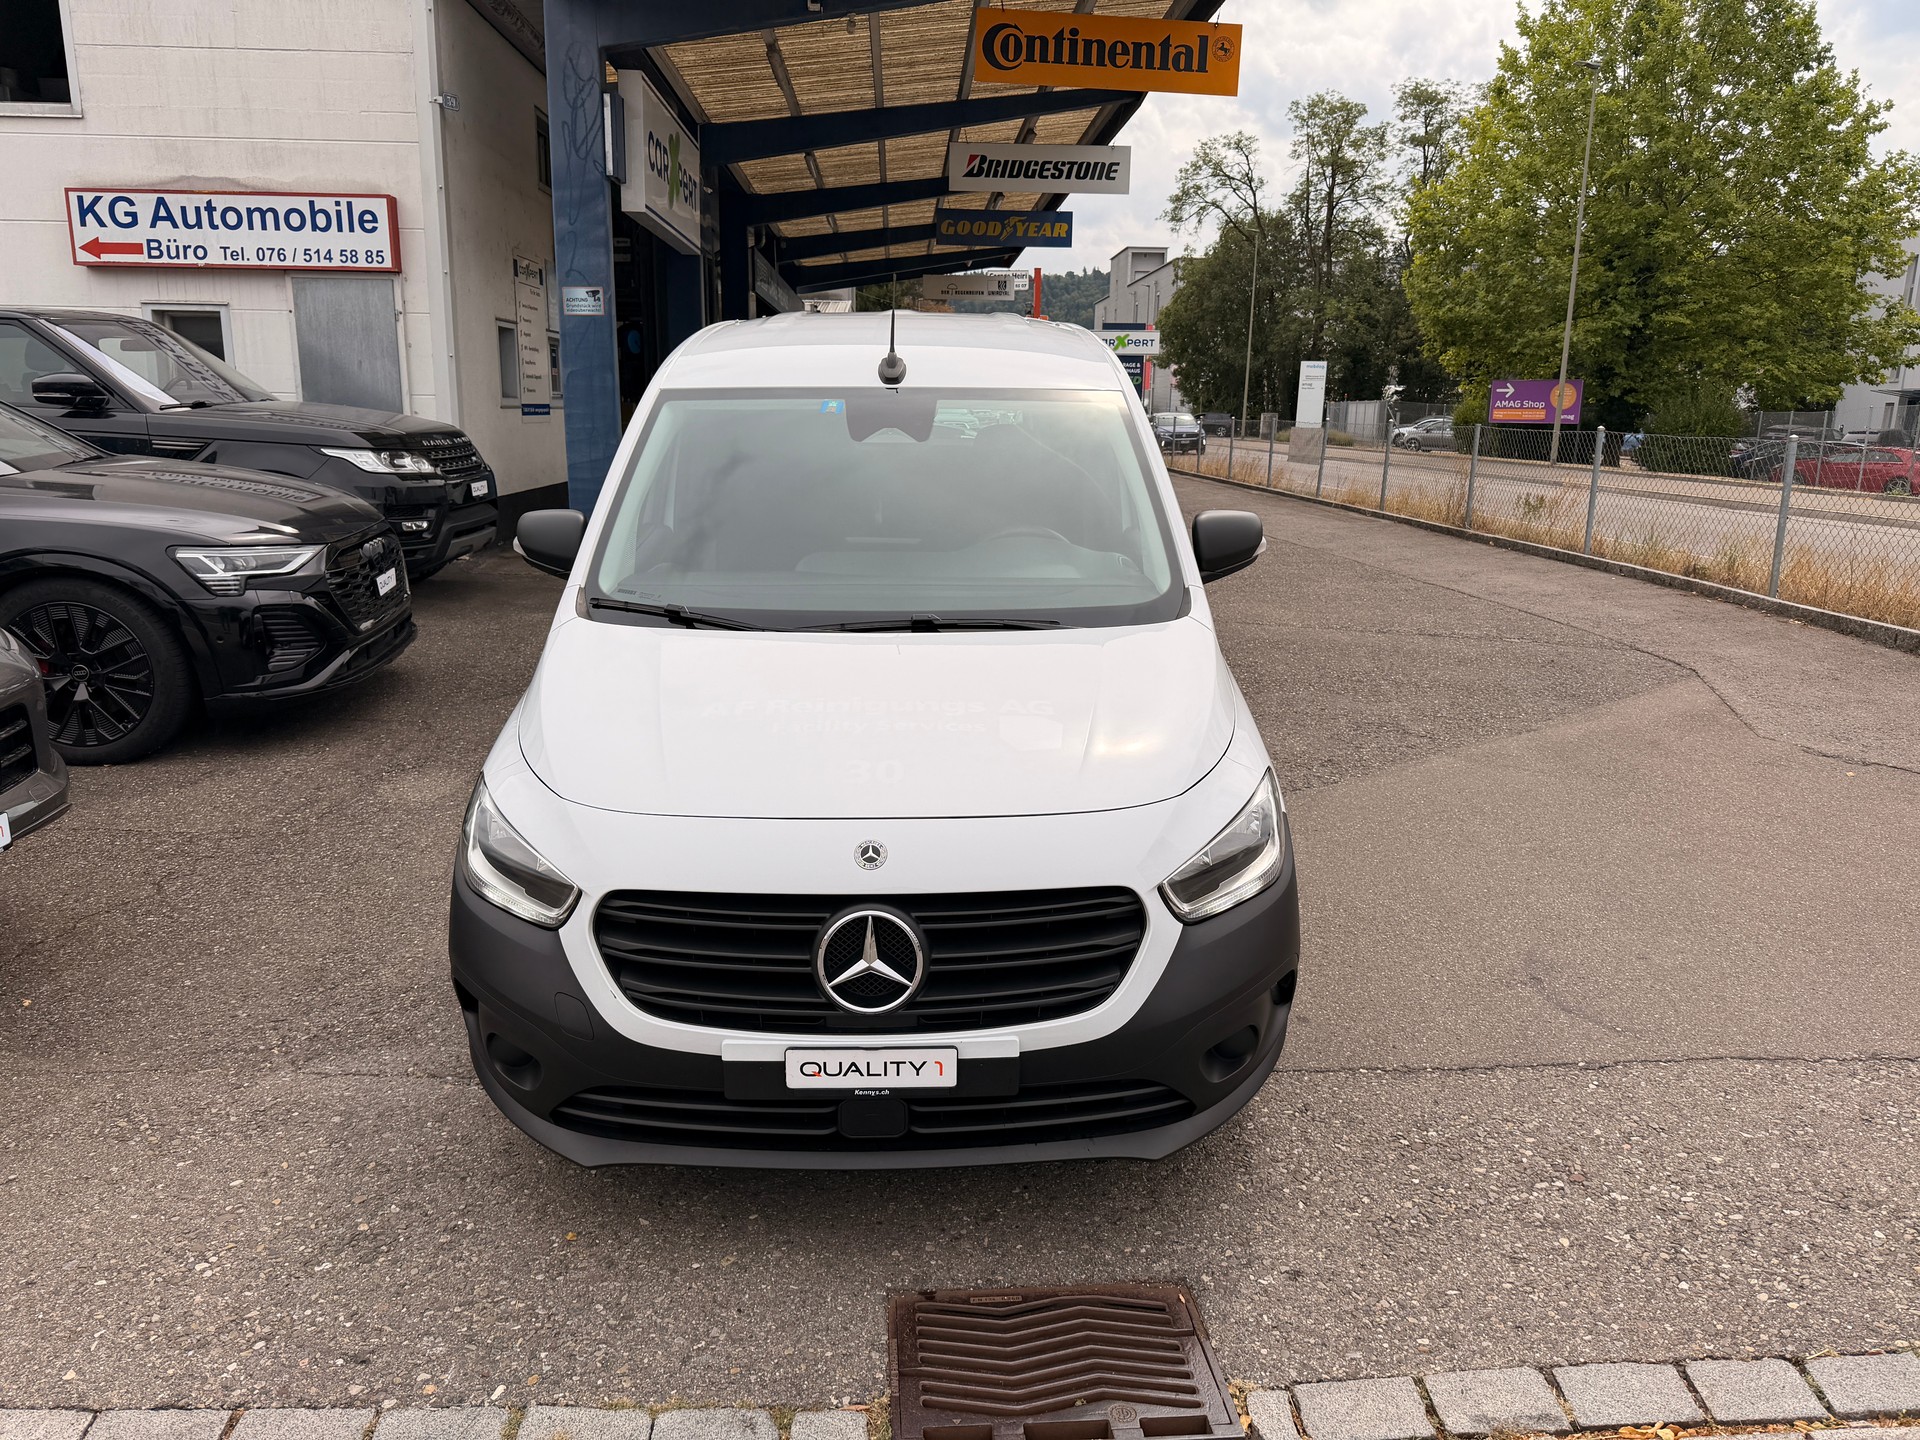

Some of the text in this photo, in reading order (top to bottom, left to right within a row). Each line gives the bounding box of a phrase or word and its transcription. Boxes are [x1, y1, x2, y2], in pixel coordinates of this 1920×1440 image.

[982, 22, 1209, 74] Continental
[962, 154, 1121, 181] BRIDGESTONE
[76, 194, 379, 234] KG Automobile
[146, 238, 385, 264] Büro Tel. 076 / 514 58 85
[1494, 400, 1545, 409] AMAG Shop
[999, 698, 1056, 716] AG
[844, 759, 905, 784] 30
[799, 1060, 943, 1078] QUALITY 1
[854, 1089, 890, 1097] Kennys.ch
